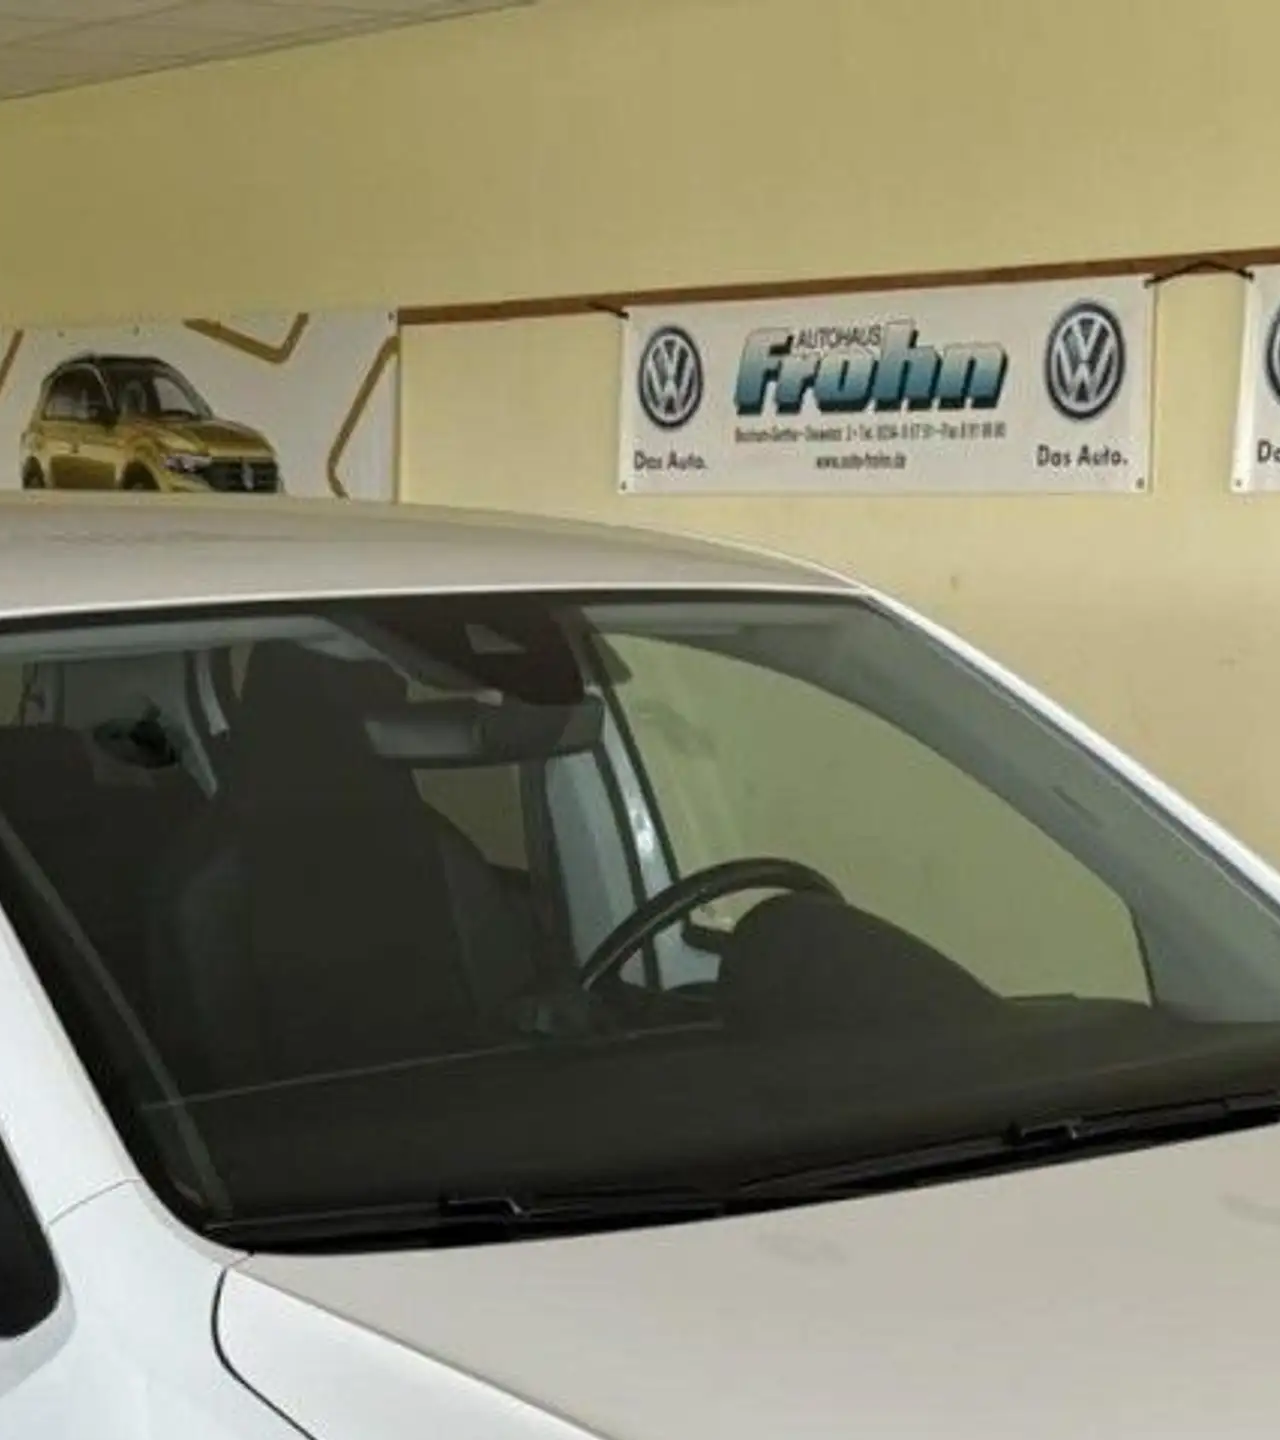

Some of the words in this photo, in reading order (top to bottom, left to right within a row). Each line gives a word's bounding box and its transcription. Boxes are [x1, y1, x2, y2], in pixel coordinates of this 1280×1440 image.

[795, 324, 882, 349] AUTOHAUS
[733, 318, 1008, 415] Frohn
[634, 450, 663, 471] Das
[666, 450, 710, 471] Auto.
[1036, 443, 1072, 467] Das
[1077, 443, 1128, 467] Auto.
